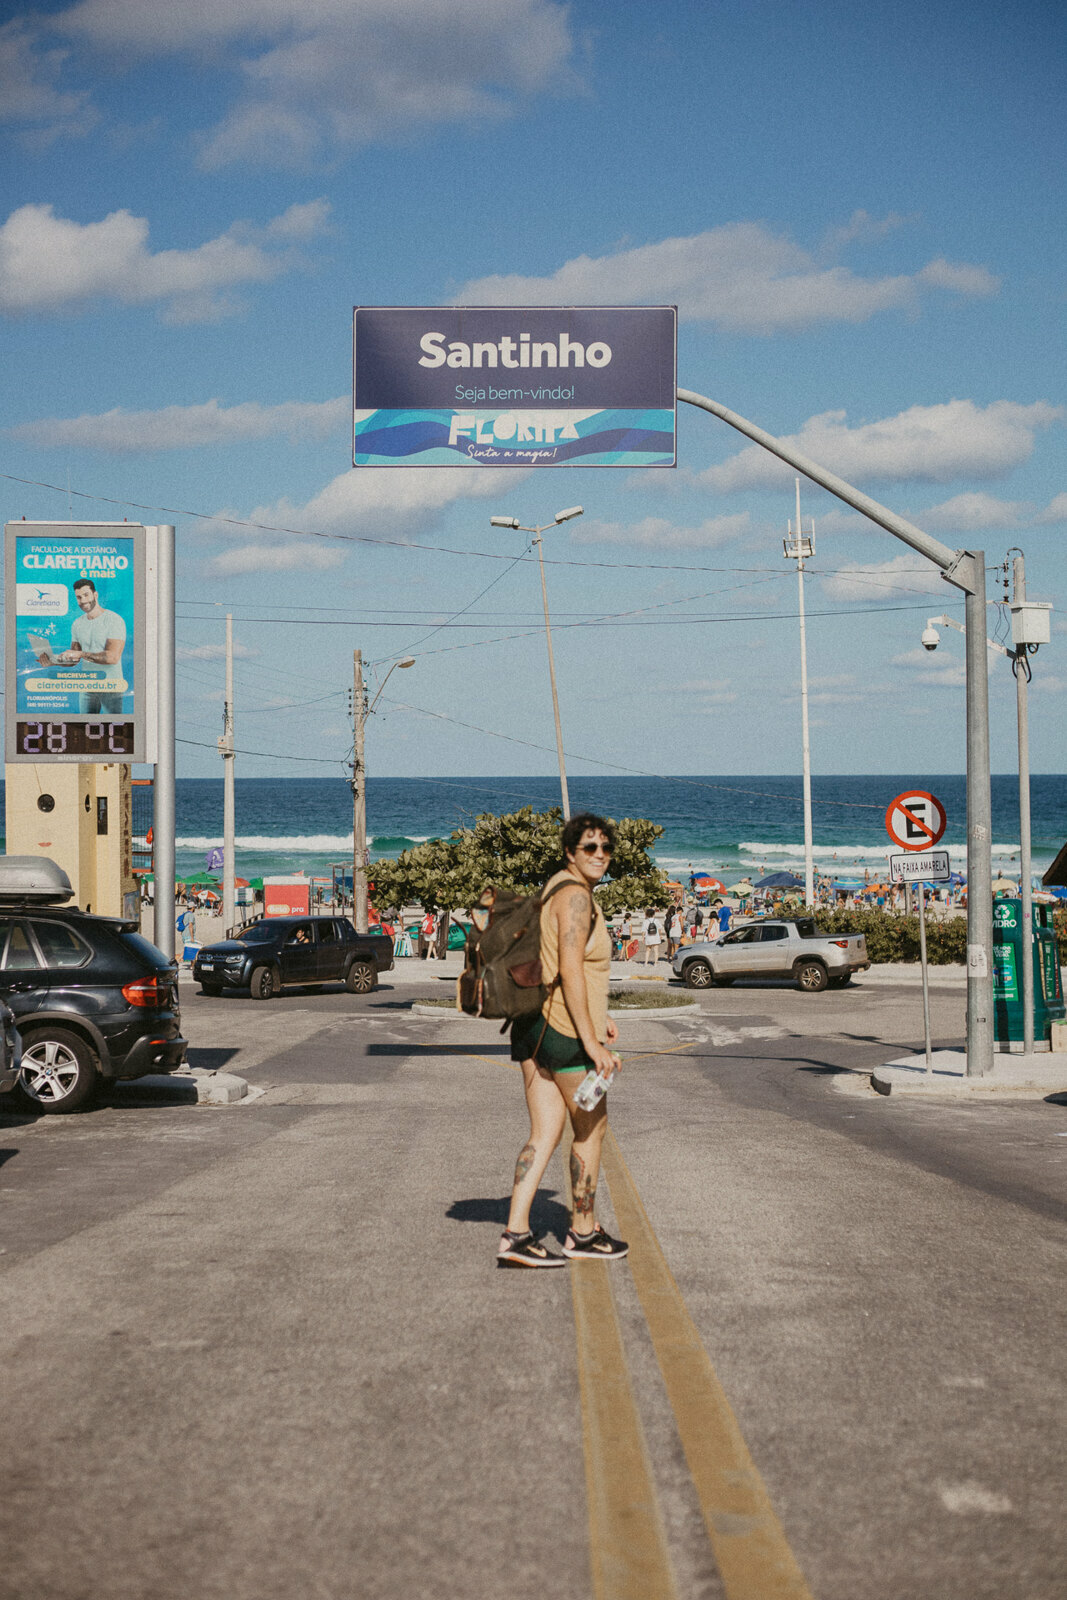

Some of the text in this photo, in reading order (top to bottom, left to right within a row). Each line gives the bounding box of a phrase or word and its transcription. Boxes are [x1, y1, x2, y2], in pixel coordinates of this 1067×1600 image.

[418, 332, 612, 369] Santinho
[455, 384, 575, 404] Seja bem-vindo!
[465, 444, 558, 463] Sinta a magia!
[81, 545, 118, 554] DISTÂNCIA
[23, 555, 128, 569] CLARETIANO
[80, 567, 116, 578] é mais
[37, 681, 117, 689] claretiano.edu.br
[23, 722, 67, 753] 28
[905, 803, 928, 838] E
[893, 860, 947, 874] NA FAIXA AMARELA
